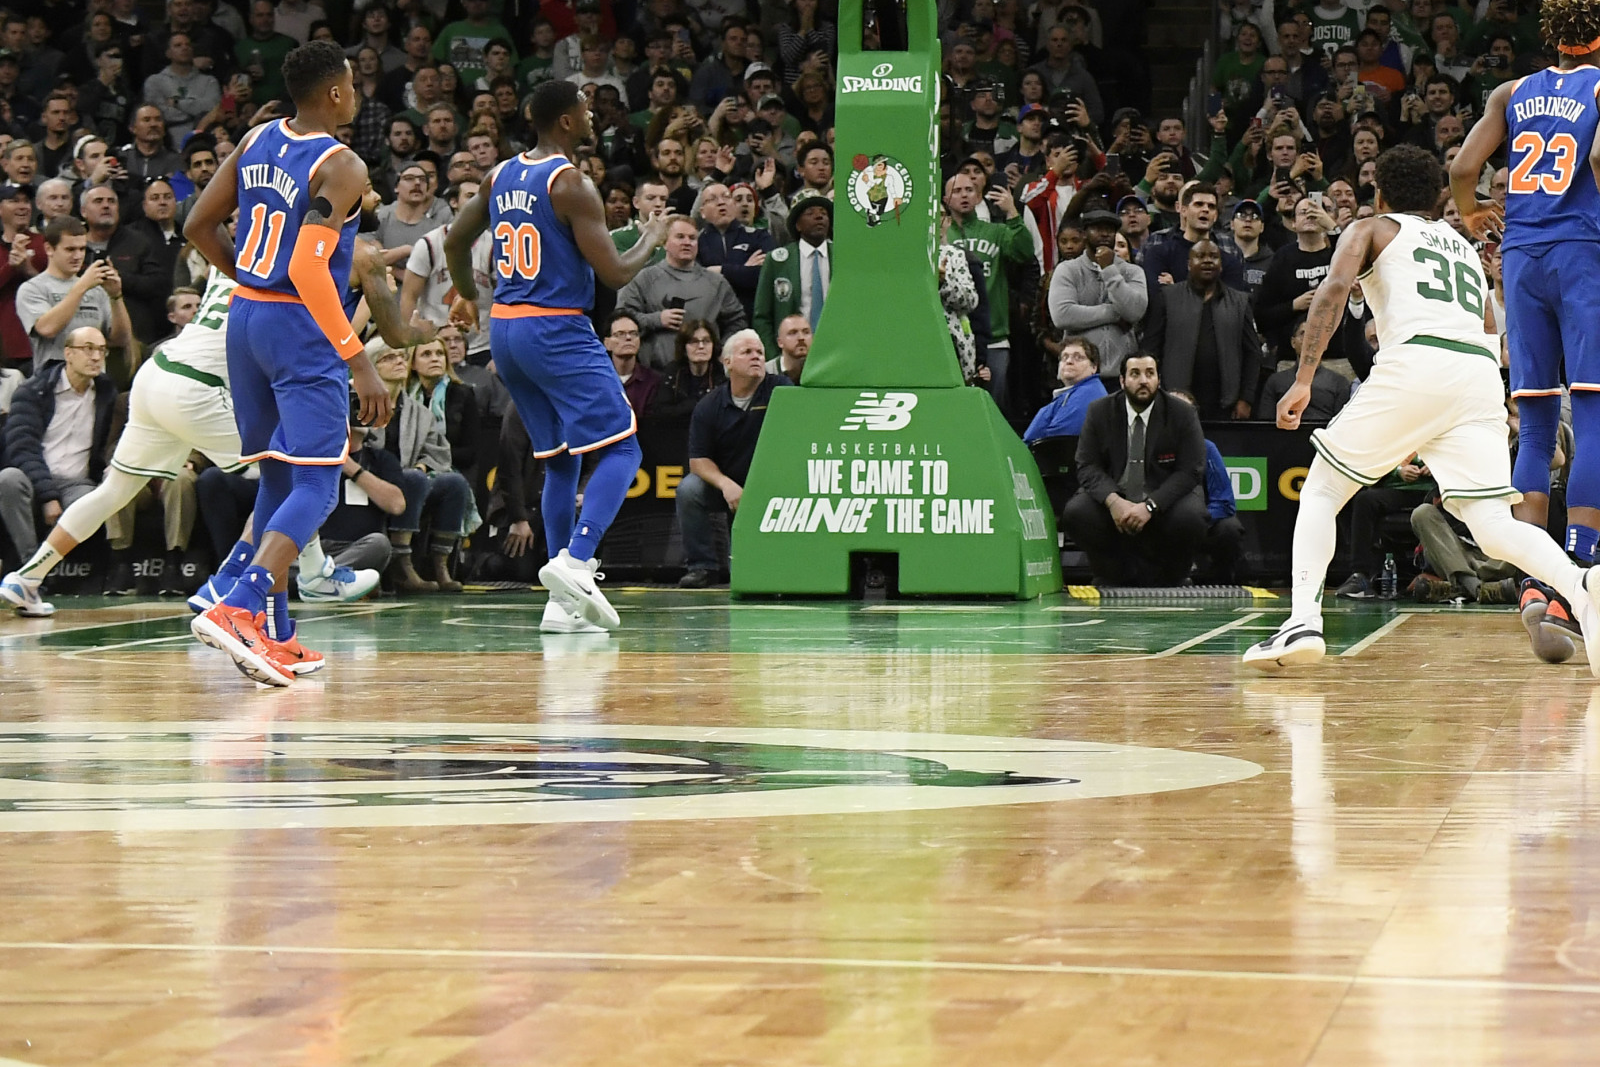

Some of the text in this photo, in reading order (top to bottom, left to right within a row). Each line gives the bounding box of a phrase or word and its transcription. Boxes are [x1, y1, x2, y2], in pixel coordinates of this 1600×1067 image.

[842, 76, 923, 93] SPALDING
[1513, 96, 1586, 123] ROBINSON
[1509, 131, 1579, 195] 23
[241, 164, 299, 209] NTILIKINA
[495, 190, 538, 215] RANDLE
[848, 170, 861, 213] BOSTON
[895, 163, 912, 204] CELTICS
[236, 203, 286, 280] 11
[494, 222, 541, 280] 30
[1419, 230, 1469, 258] SMART
[1412, 247, 1483, 320] 36
[811, 443, 942, 455] BASKETBALL
[807, 459, 948, 495] WE CAME TO
[759, 498, 994, 534] CHANGE THE GAME
